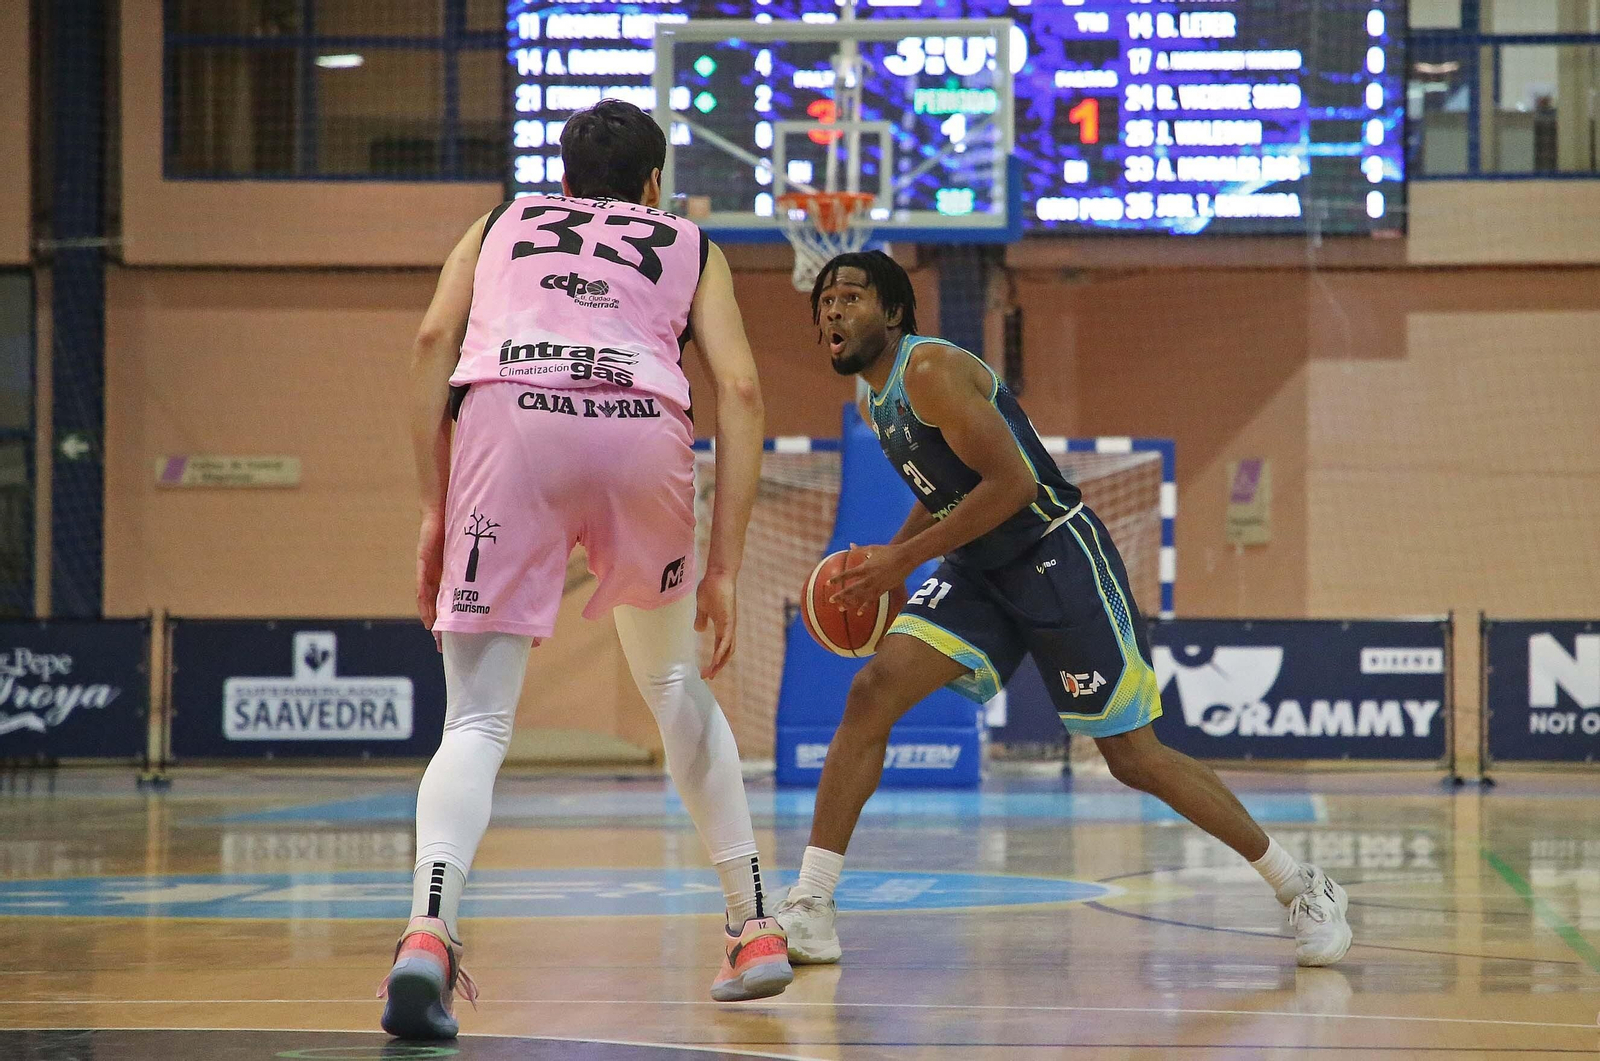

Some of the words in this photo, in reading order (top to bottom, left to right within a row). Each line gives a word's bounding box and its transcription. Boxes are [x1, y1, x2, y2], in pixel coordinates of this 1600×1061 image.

[1069, 98, 1098, 144] 1
[511, 205, 678, 286] 33
[499, 338, 596, 363] intra
[499, 363, 569, 377] Climatización
[570, 362, 634, 388] gas
[517, 392, 578, 417] CAJA
[902, 459, 937, 496] 21
[906, 577, 953, 610] 21
[234, 699, 400, 731] SAAVEDRA
[1201, 699, 1441, 738] GRAMMY
[1529, 711, 1578, 736] NOT
